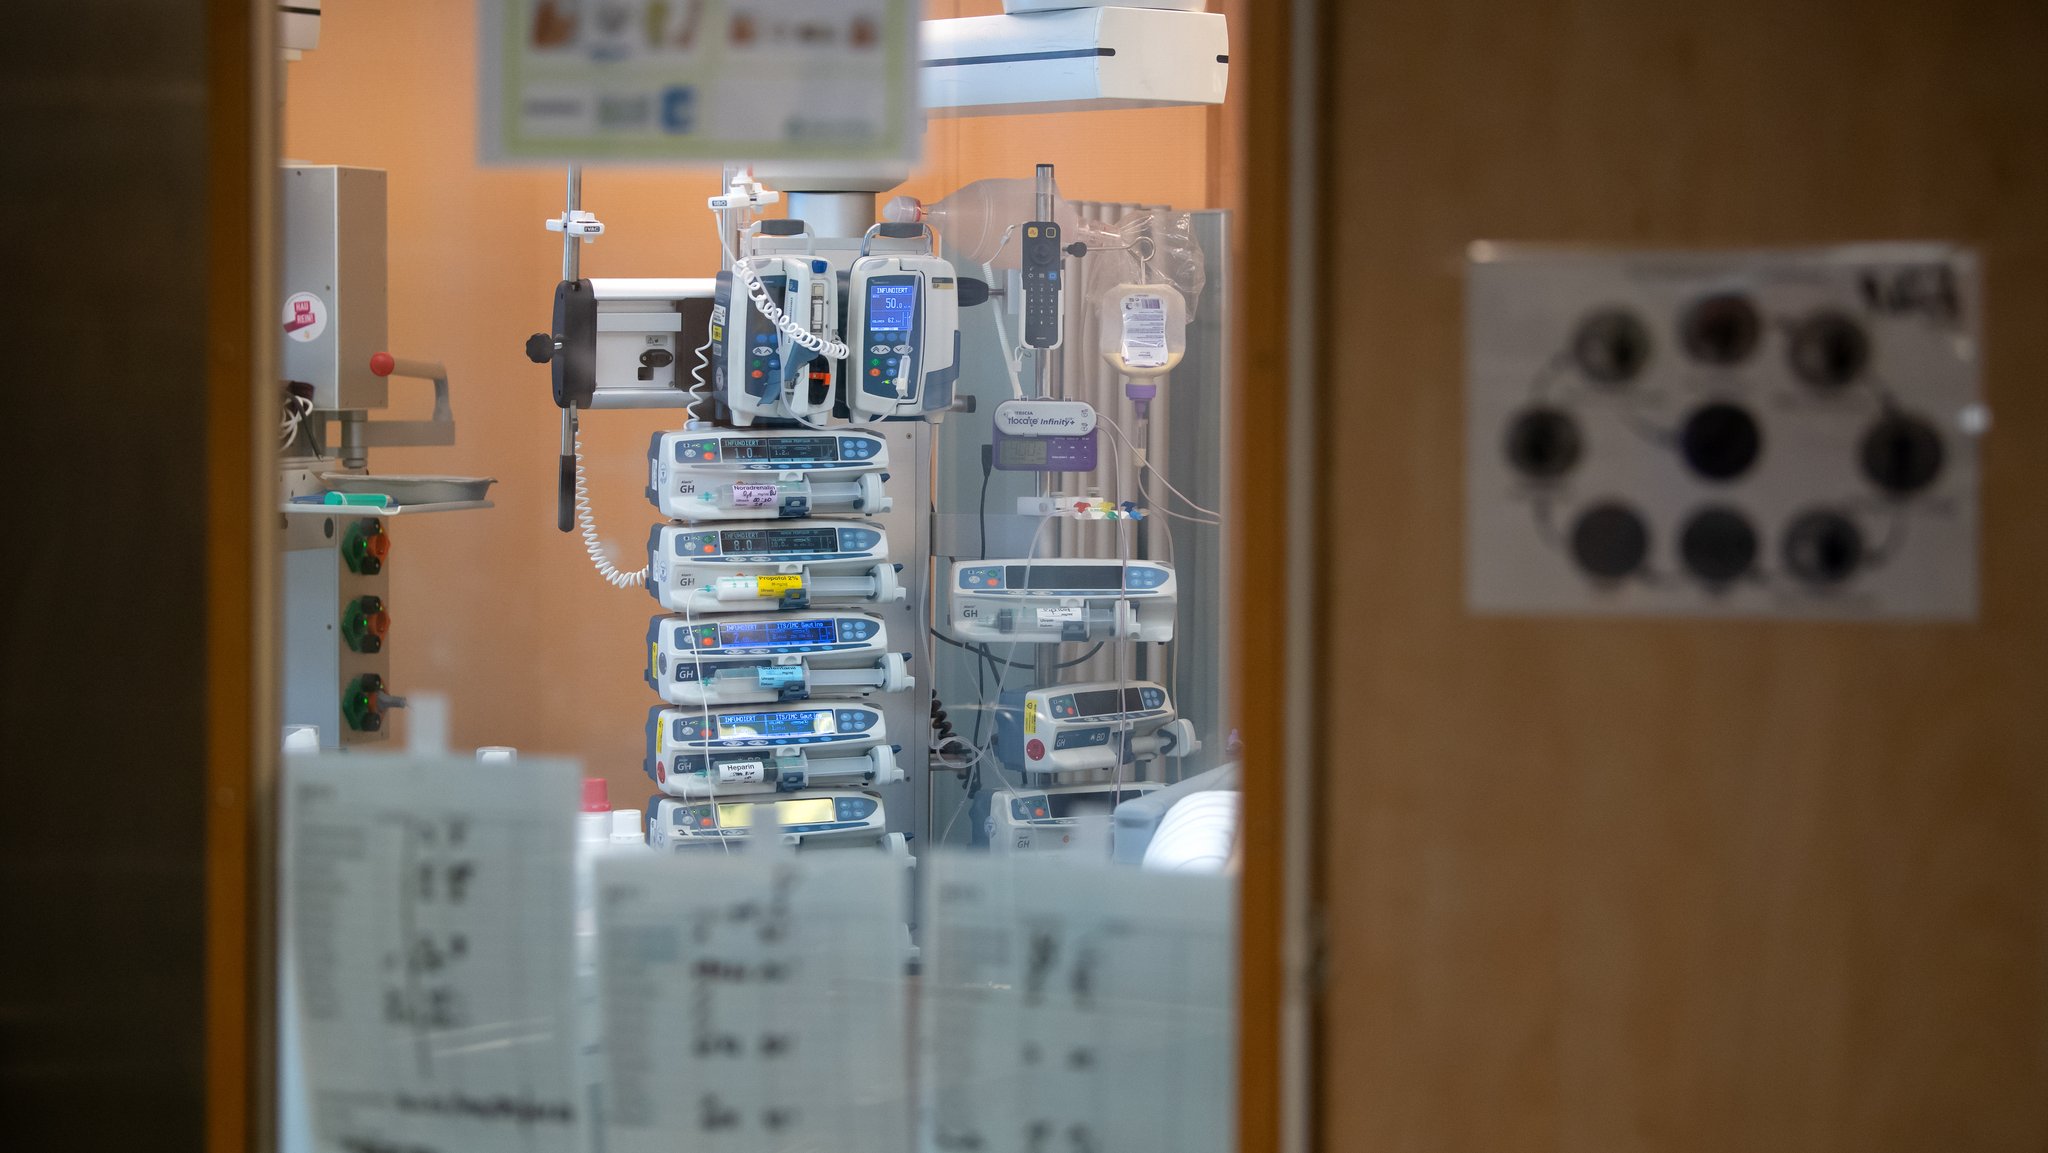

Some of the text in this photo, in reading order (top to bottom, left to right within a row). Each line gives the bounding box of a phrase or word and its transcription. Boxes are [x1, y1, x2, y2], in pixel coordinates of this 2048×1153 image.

[735, 447, 753, 459] 1.0
[680, 485, 695, 494] GH
[733, 539, 753, 550] 8.0
[680, 578, 695, 586] GH
[963, 609, 978, 618] GH
[680, 670, 693, 678] GH
[677, 762, 692, 771] GH
[727, 764, 755, 772] Heparin
[1017, 840, 1030, 849] GH
